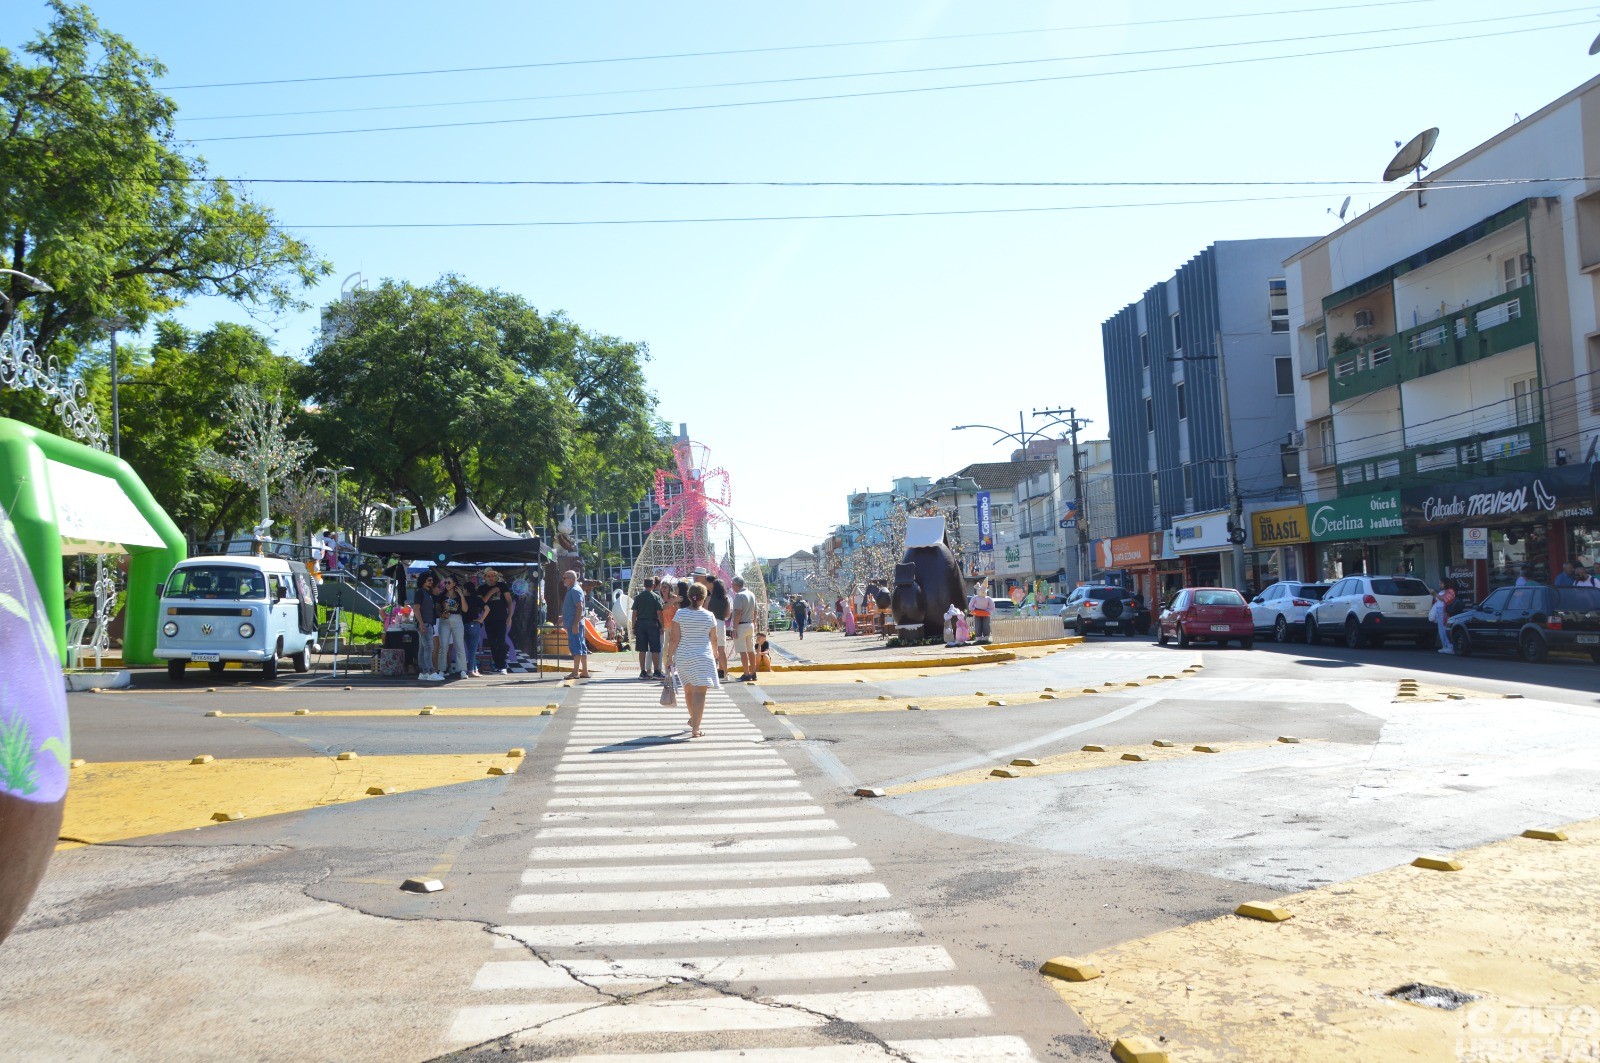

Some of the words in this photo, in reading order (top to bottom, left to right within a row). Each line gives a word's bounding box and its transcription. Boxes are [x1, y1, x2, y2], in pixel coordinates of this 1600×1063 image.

[1370, 495, 1390, 511] Ótica
[1421, 496, 1465, 522] Calçados
[1467, 487, 1528, 516] TREVISOL
[981, 497, 990, 535] Colombo
[1311, 505, 1364, 537] Getelina
[1369, 514, 1403, 530] Joalheria
[1260, 519, 1301, 541] BRASIL
[1472, 530, 1478, 538] E
